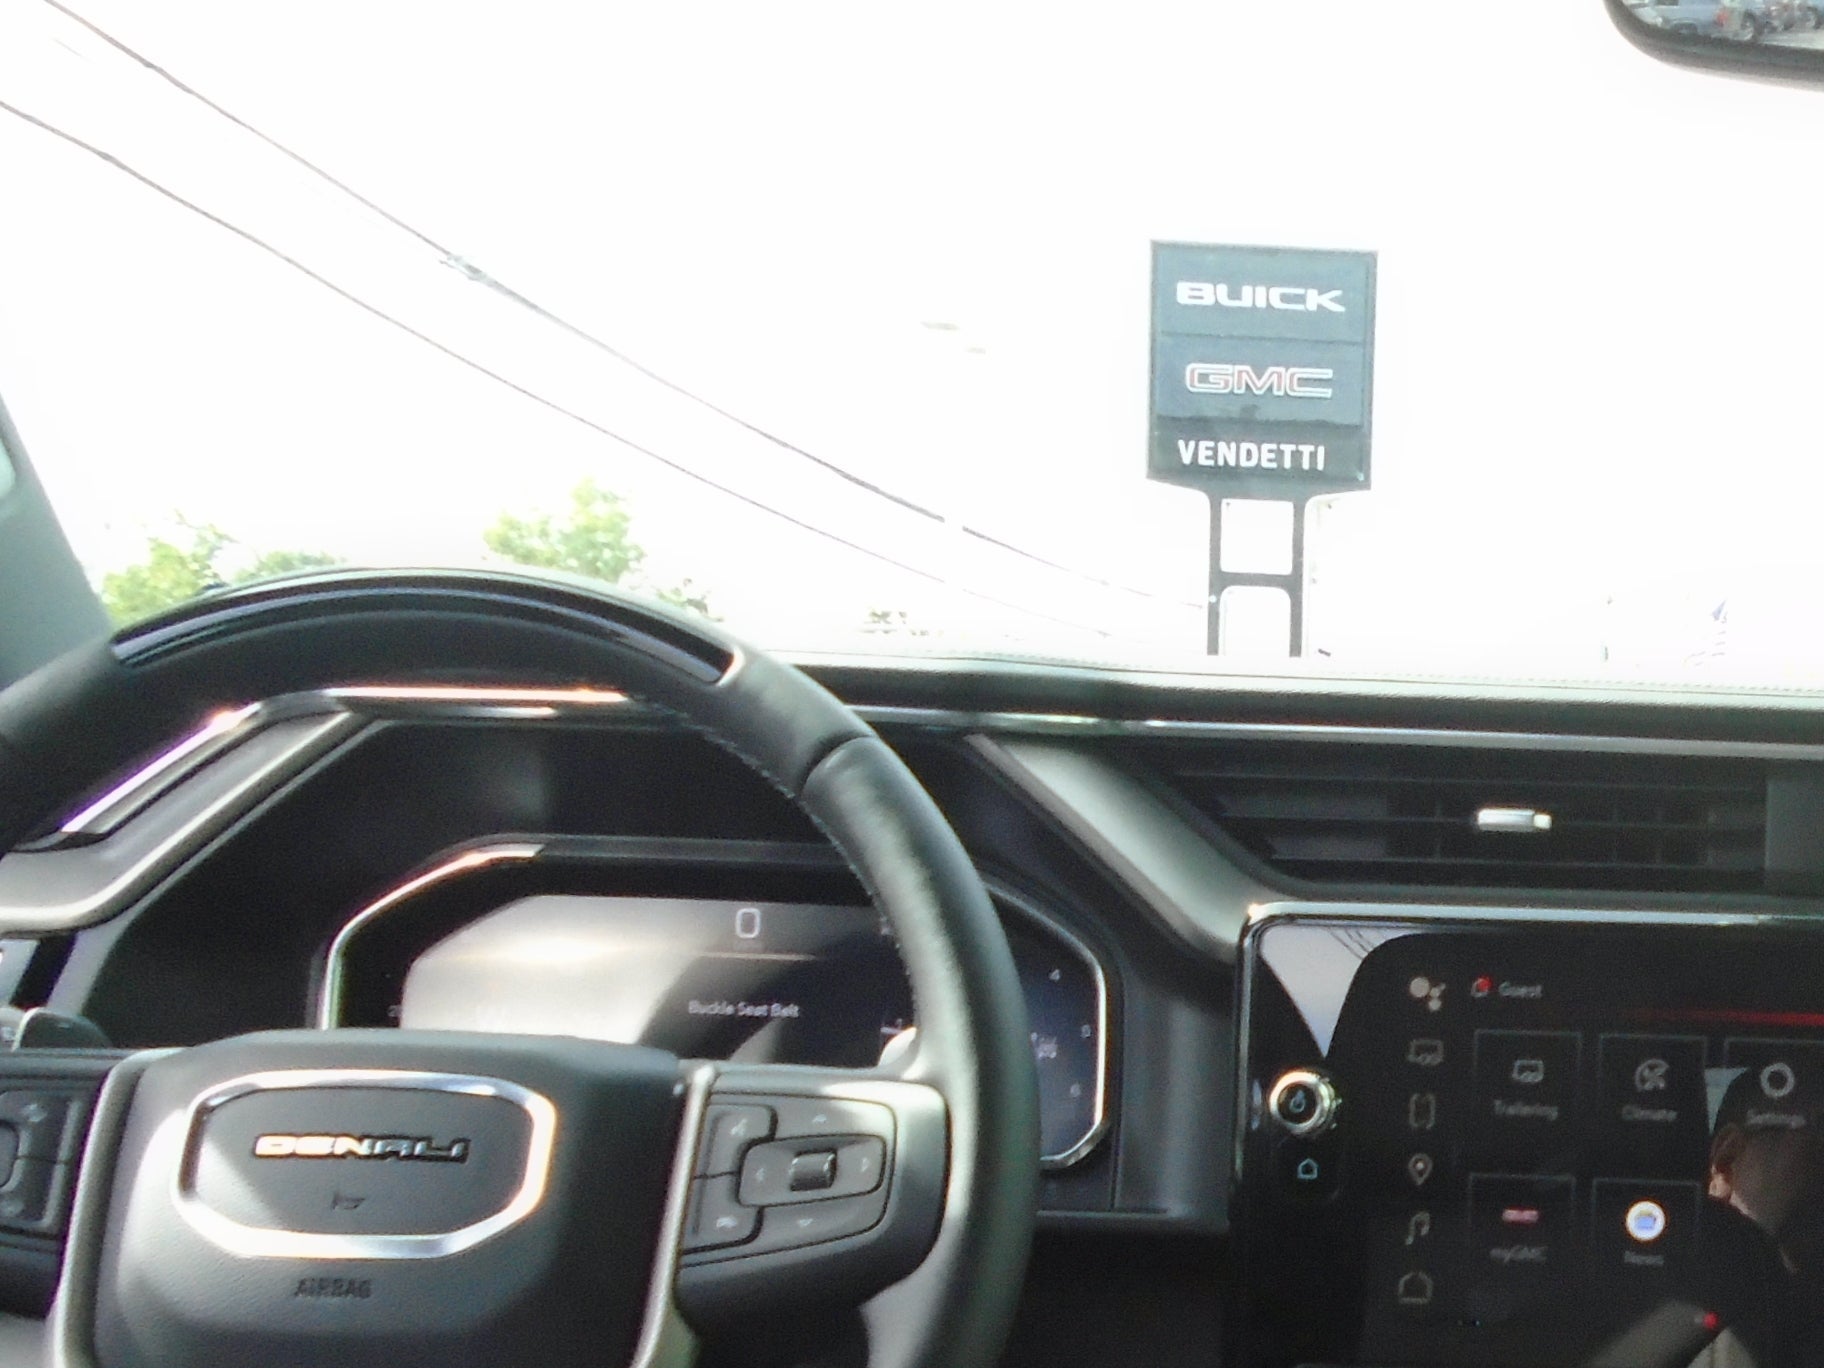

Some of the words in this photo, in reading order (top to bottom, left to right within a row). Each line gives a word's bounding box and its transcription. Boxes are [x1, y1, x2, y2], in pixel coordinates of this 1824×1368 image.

[1176, 281, 1346, 313] BUICK
[1185, 362, 1334, 398] GMC
[1177, 439, 1325, 471] VENDETTI
[254, 1133, 471, 1163] DENALI
